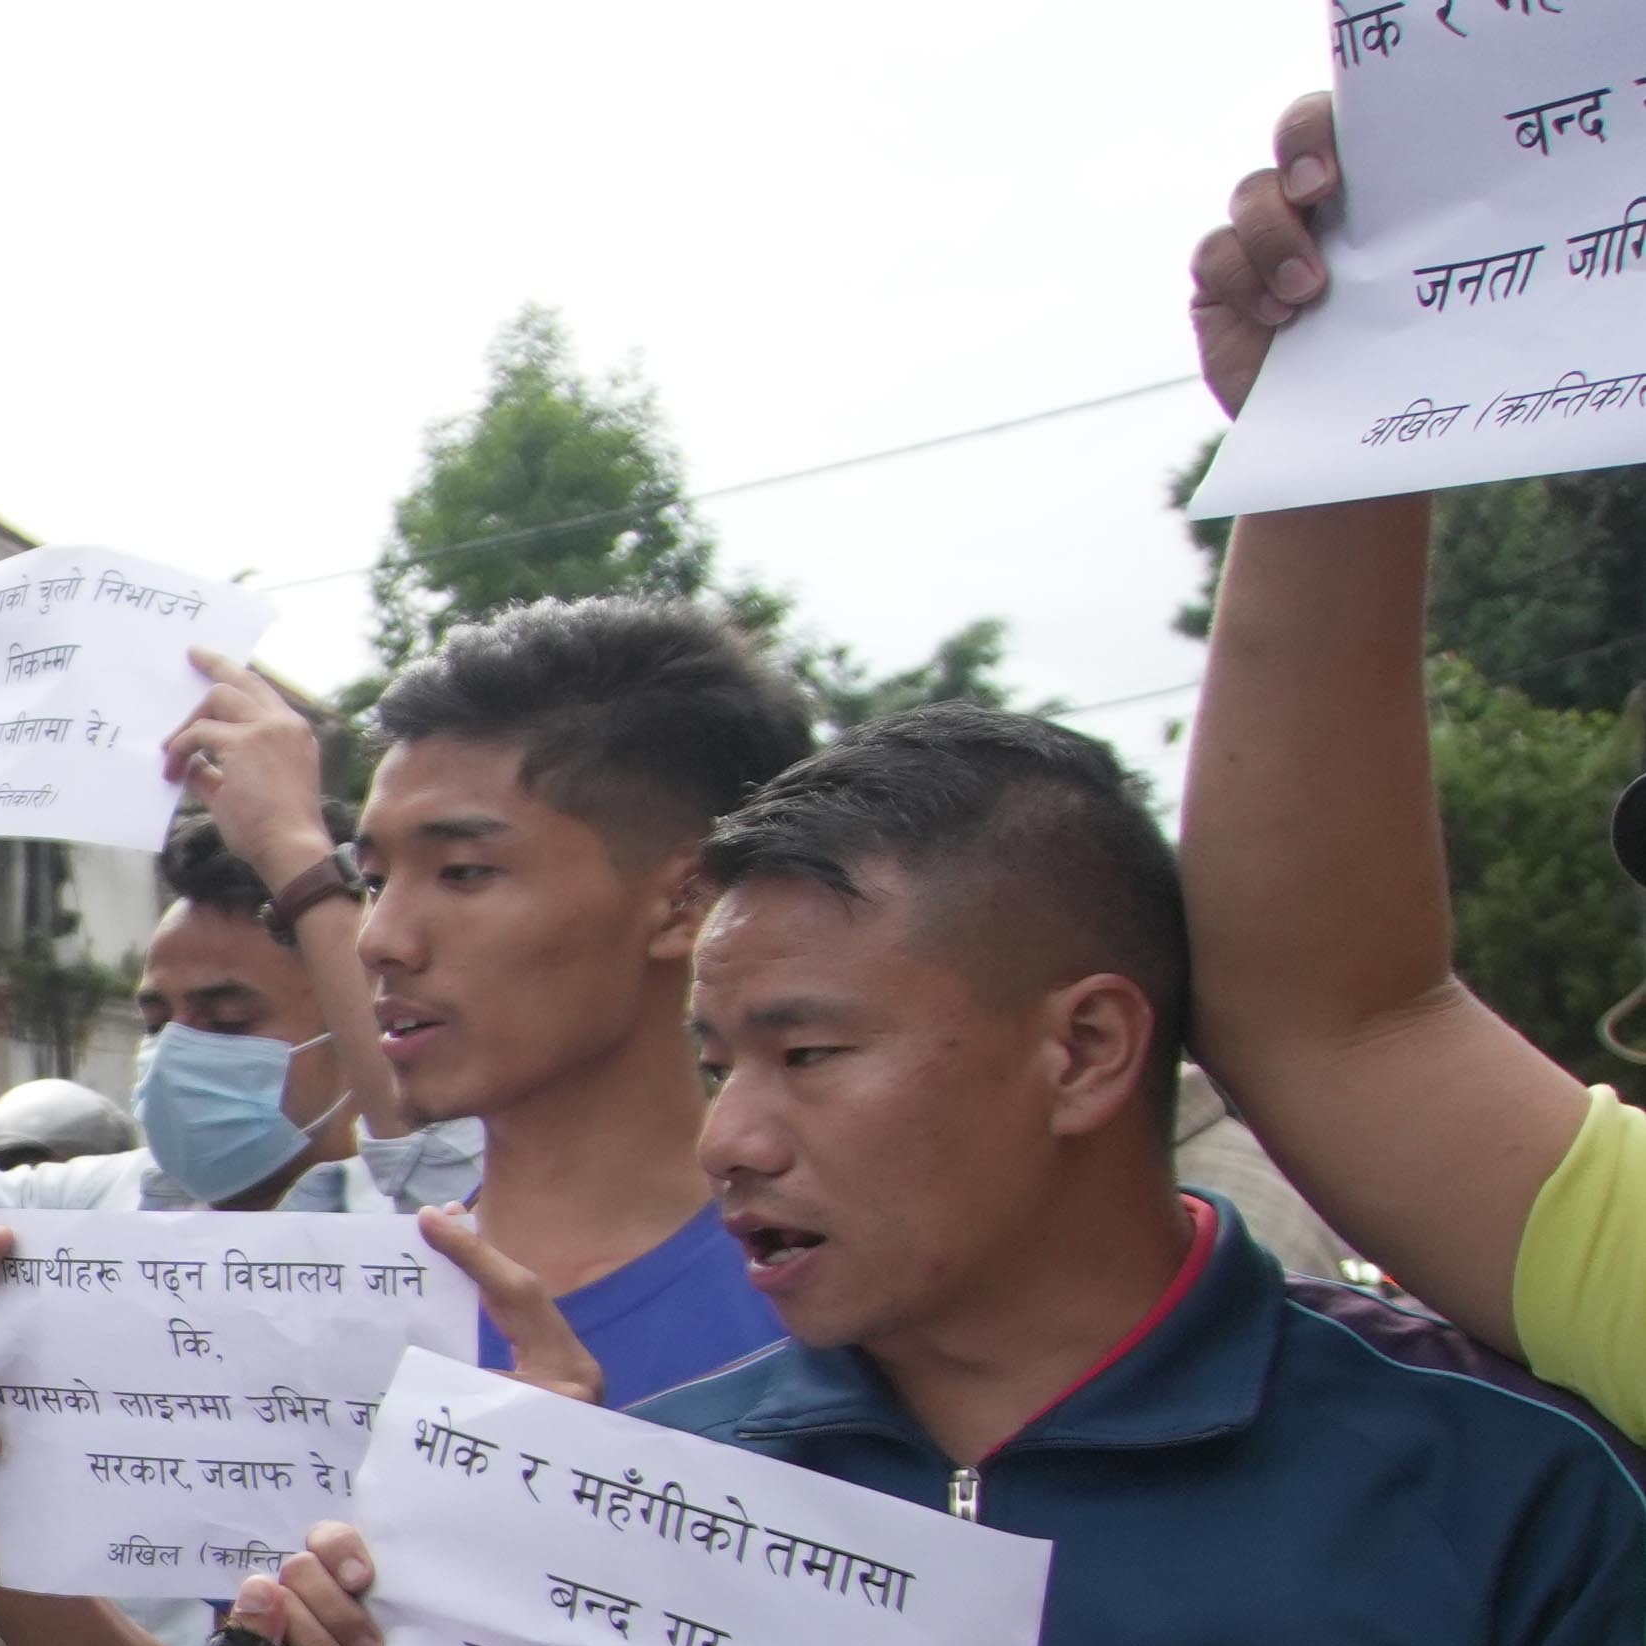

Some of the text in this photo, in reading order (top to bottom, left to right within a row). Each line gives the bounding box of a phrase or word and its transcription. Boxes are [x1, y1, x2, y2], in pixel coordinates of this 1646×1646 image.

[1503, 87, 1612, 156] बन्द
[1413, 245, 1545, 313] जनता
[1362, 397, 1470, 447] अखिल
[39, 567, 85, 614] चुलो
[93, 569, 208, 620] निभाउने
[223, 1249, 346, 1295] विद्यालय
[361, 1252, 428, 1298] जाने
[113, 1390, 231, 1424] लाइनमा
[246, 1385, 331, 1428] उभिन
[196, 1458, 295, 1492] जवाफ
[414, 1406, 915, 1613] भोक र महँगीको तमासा
[107, 1534, 182, 1567] अखिल
[546, 1573, 641, 1640] बन्द
